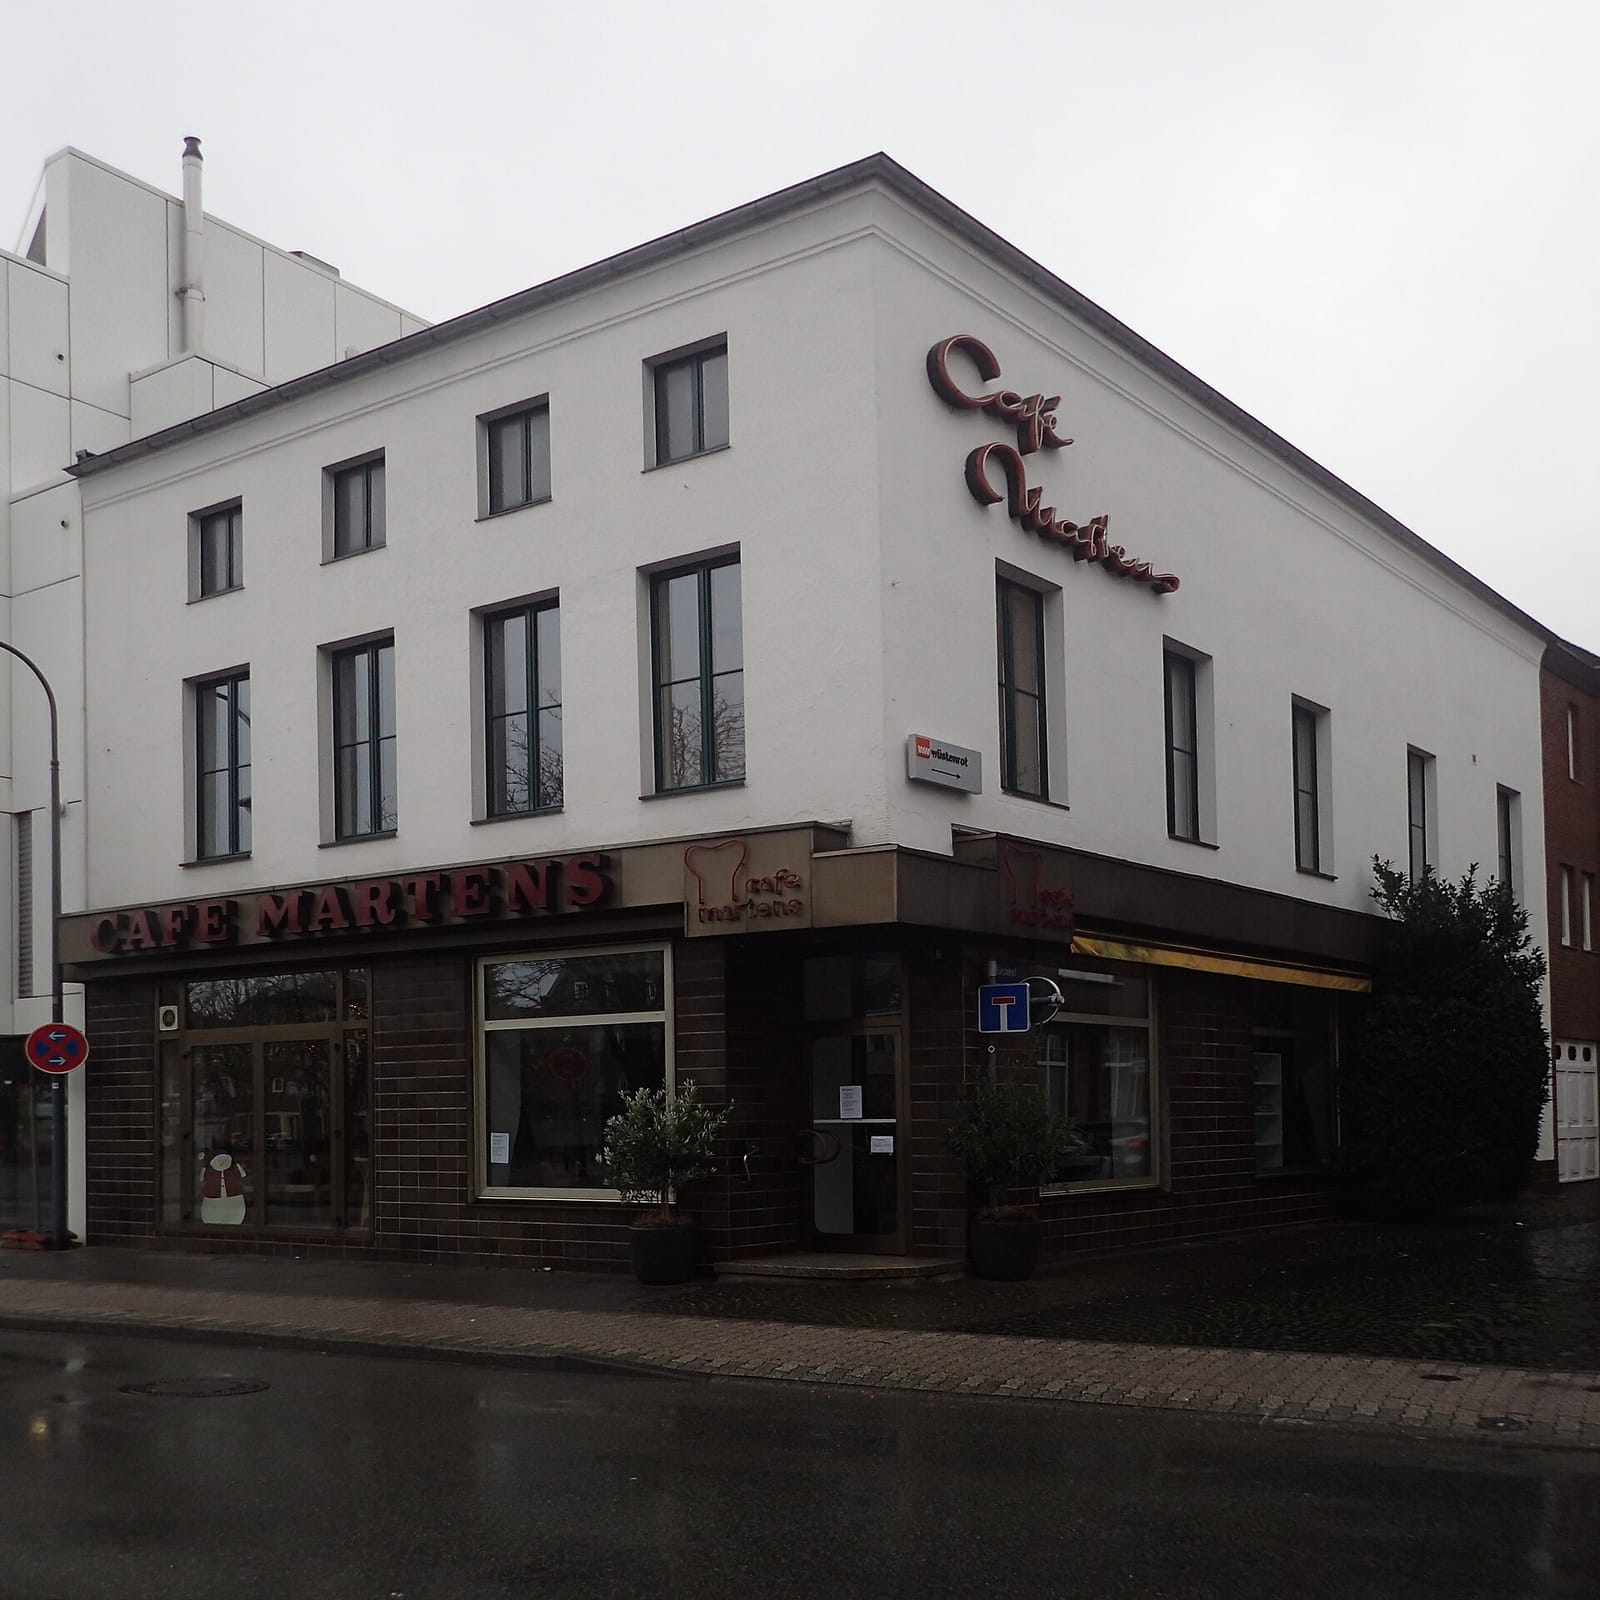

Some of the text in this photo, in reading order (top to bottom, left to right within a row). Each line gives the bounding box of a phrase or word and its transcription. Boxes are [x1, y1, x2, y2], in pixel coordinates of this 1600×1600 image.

[930, 748, 969, 767] wüstenrot
[745, 868, 801, 896] cafe
[91, 853, 609, 954] CAFE MARTENS
[698, 898, 802, 923] martens
